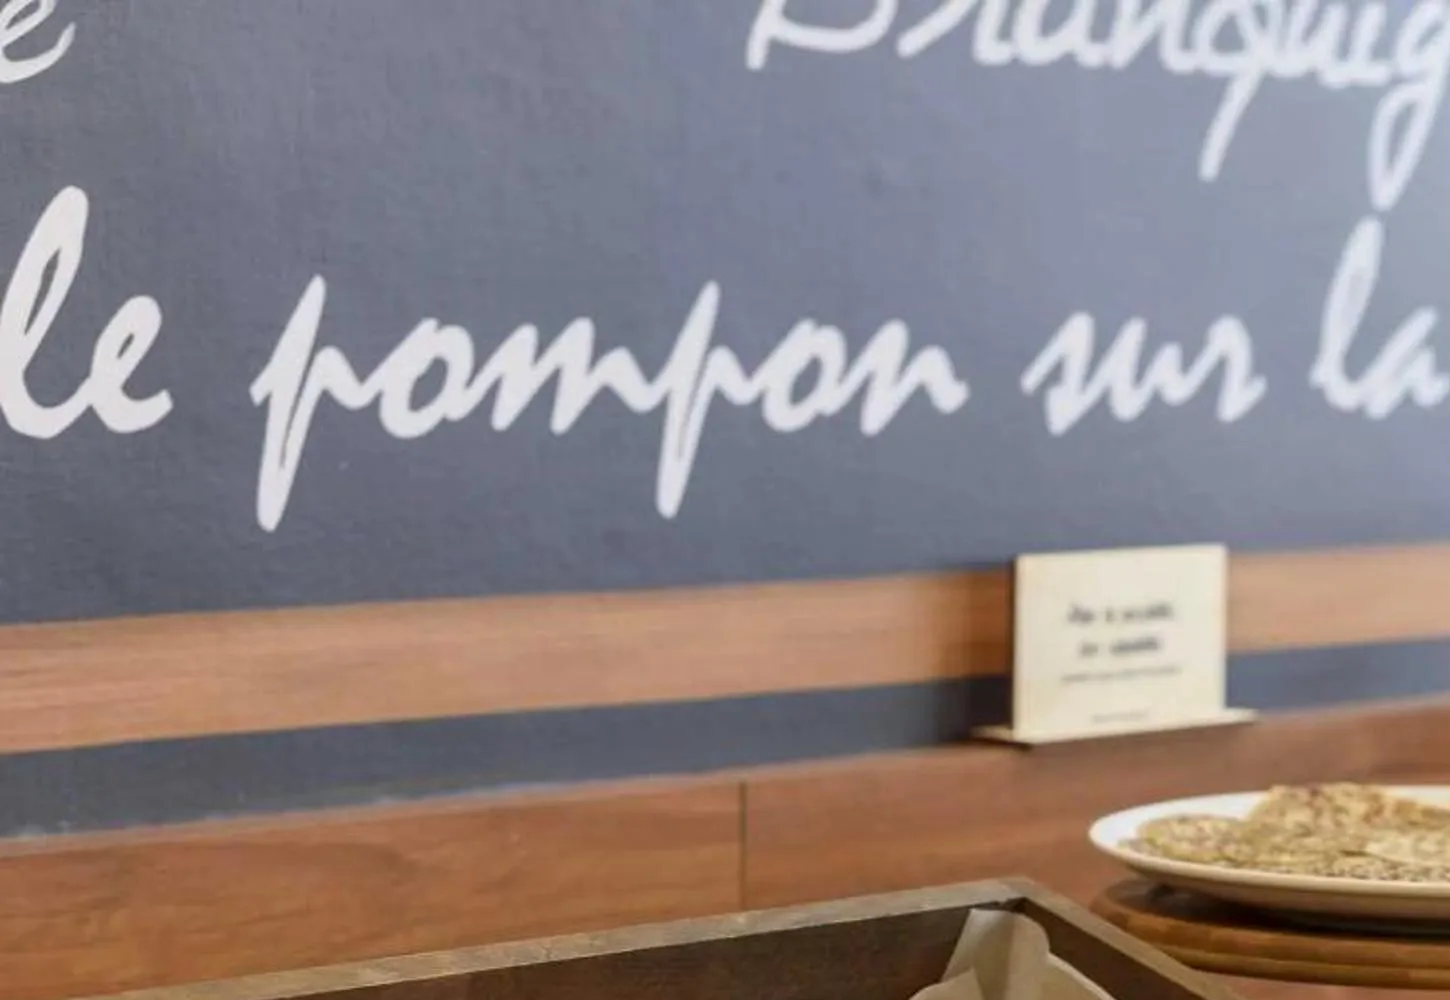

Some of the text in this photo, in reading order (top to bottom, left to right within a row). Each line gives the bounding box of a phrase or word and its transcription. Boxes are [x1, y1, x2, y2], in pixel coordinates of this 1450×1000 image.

[0, 185, 173, 438] le
[250, 275, 969, 532] pompon
[1021, 312, 1266, 435] sur
